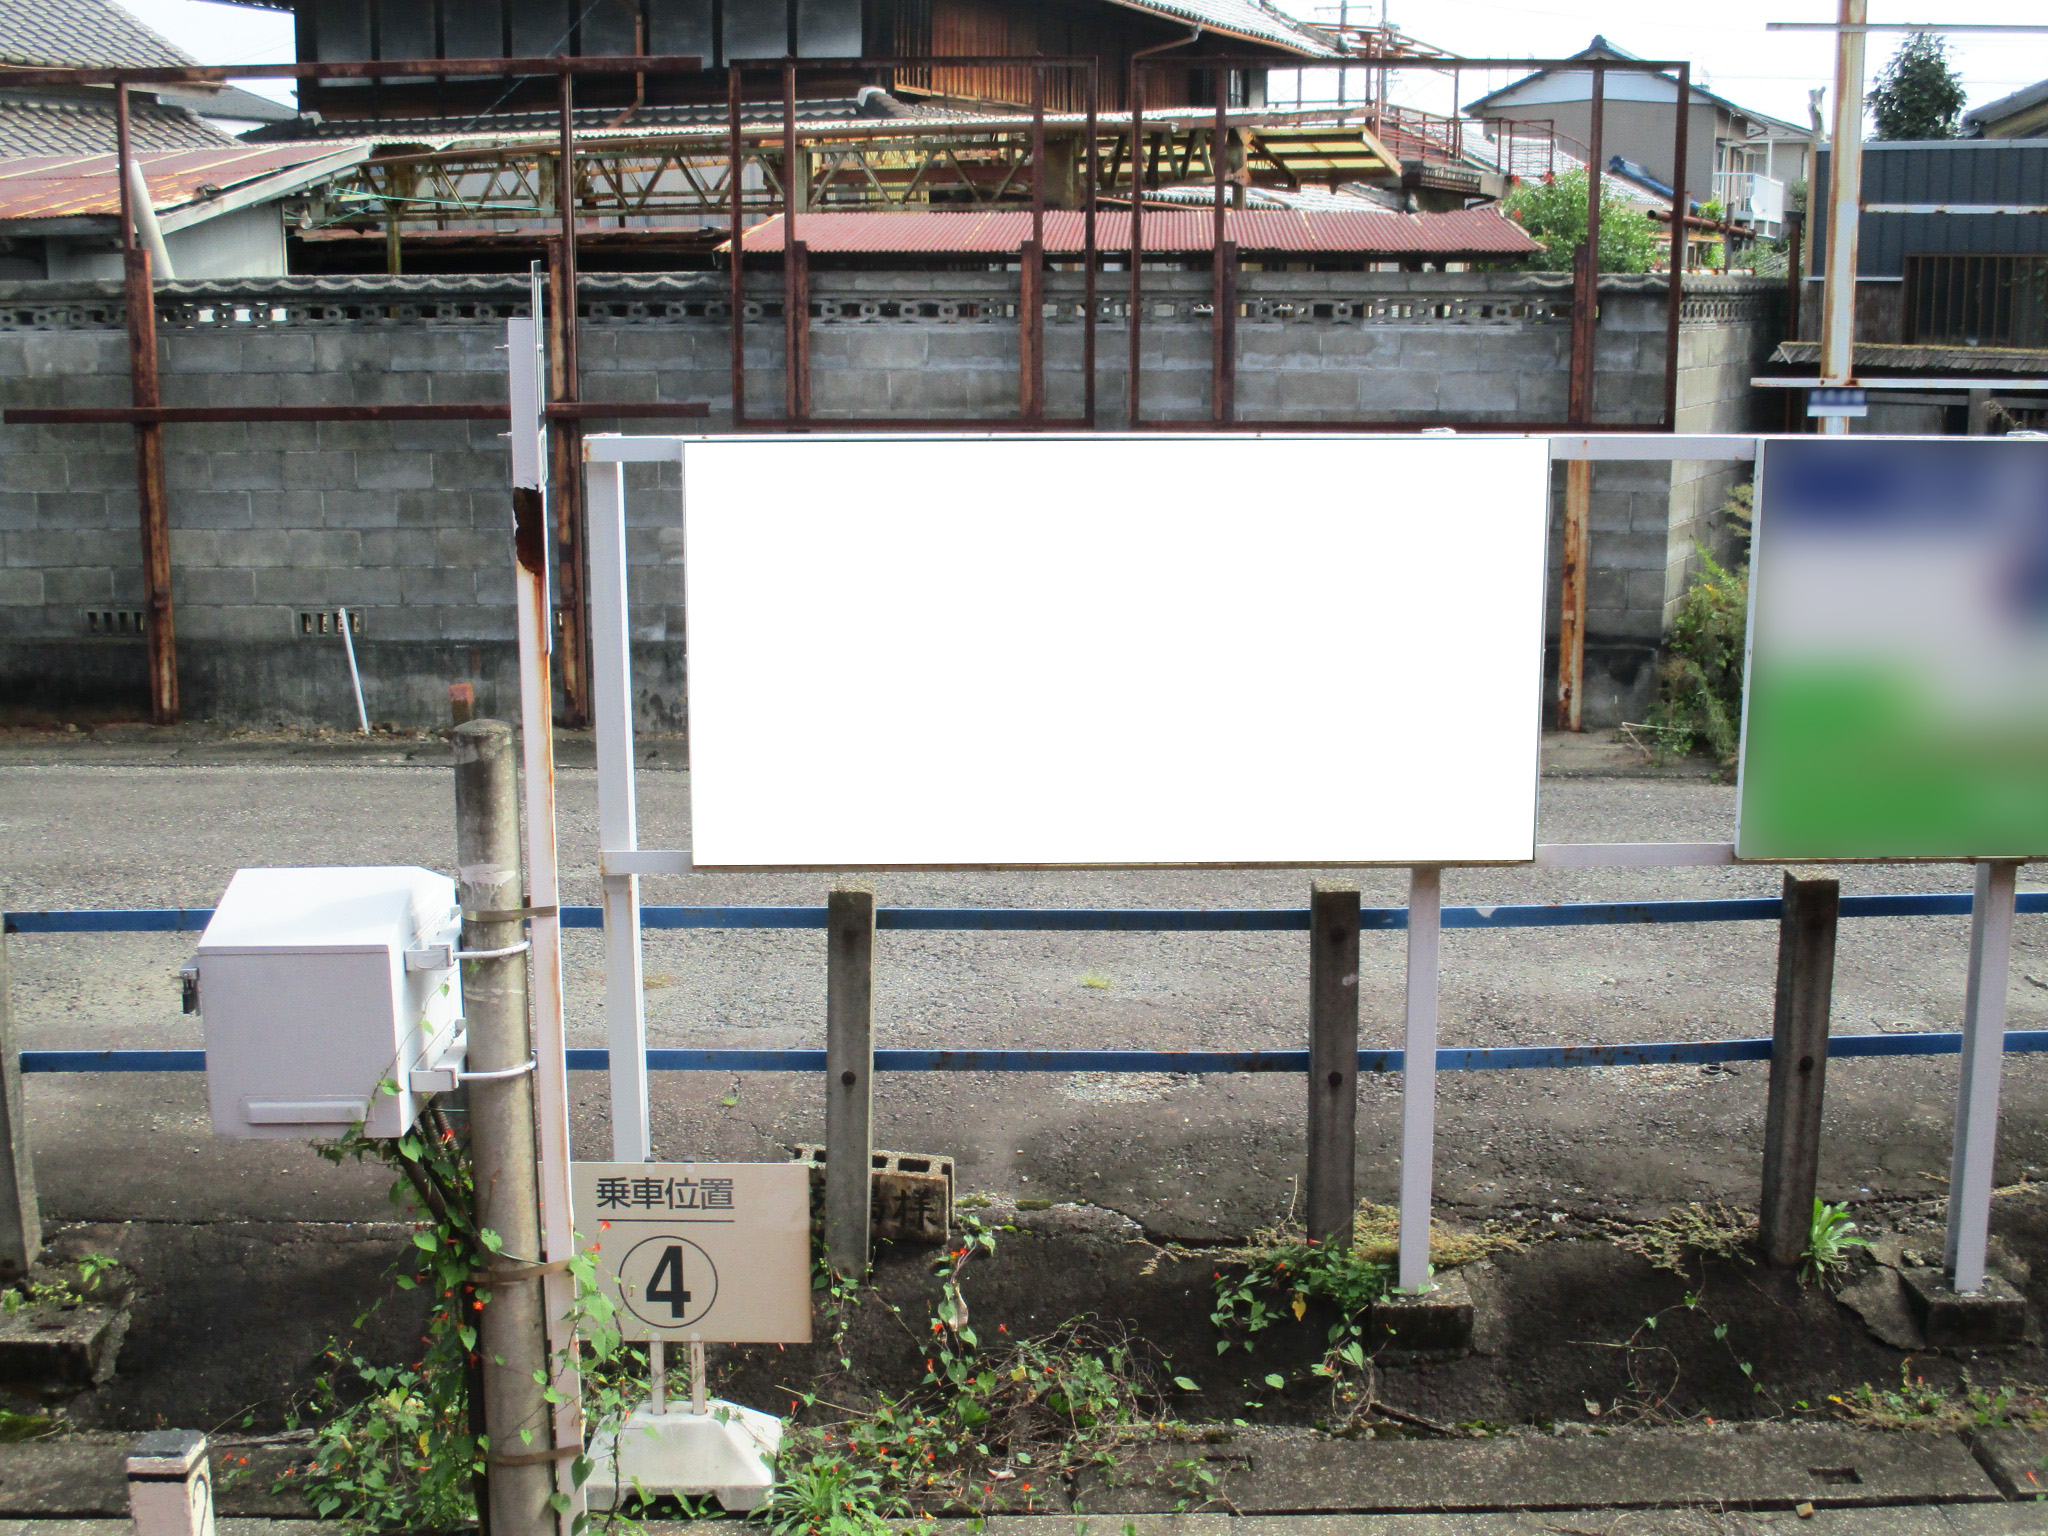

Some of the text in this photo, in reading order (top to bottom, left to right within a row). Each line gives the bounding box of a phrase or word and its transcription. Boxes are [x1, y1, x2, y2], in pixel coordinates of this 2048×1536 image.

[596, 1177, 735, 1210] 乗車位置
[645, 1245, 692, 1319] 4
